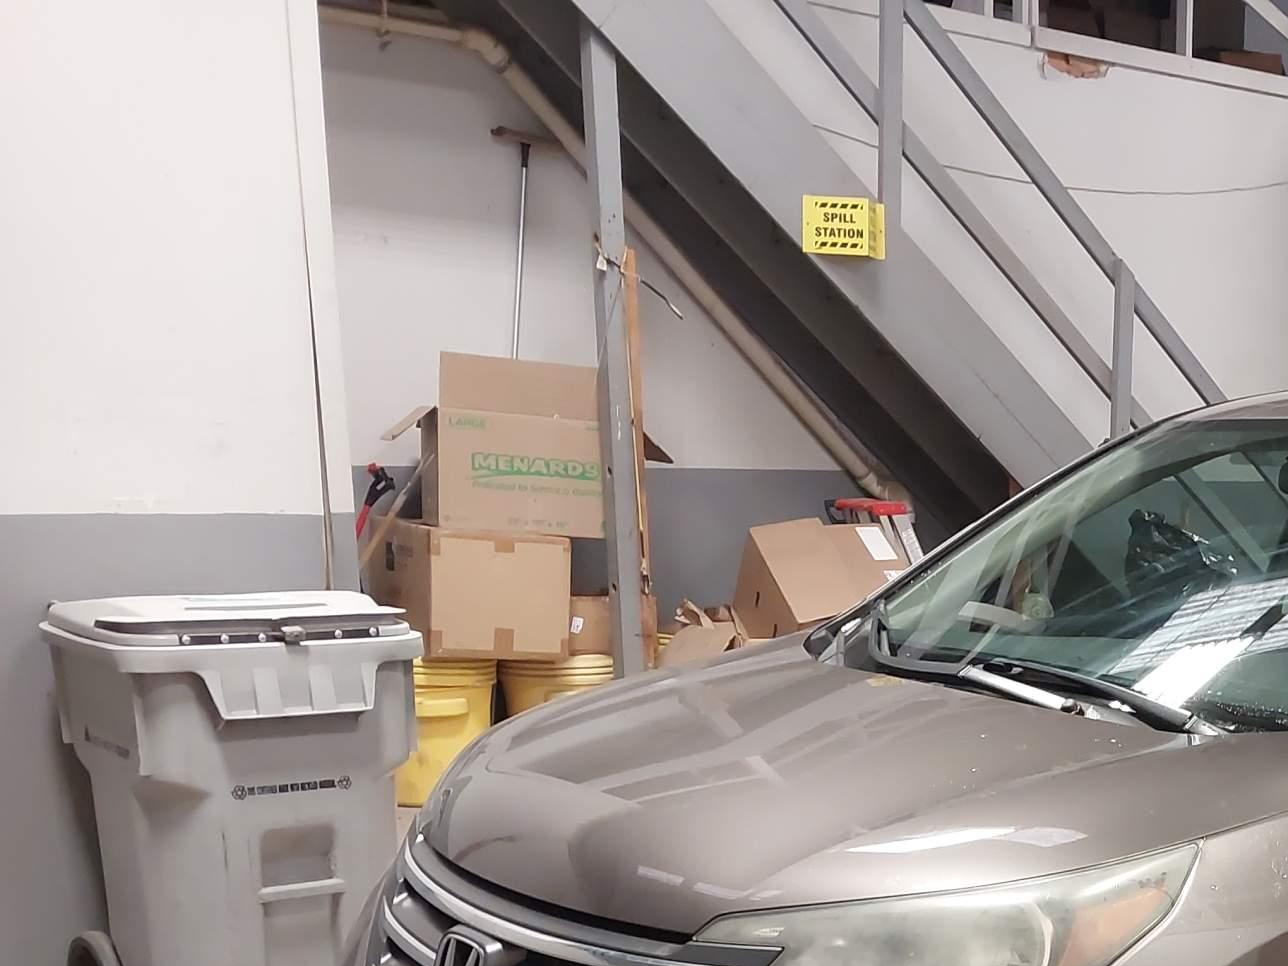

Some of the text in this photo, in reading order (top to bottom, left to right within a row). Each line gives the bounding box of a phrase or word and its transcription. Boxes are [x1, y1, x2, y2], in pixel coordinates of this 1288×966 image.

[823, 212, 856, 224] SPILL
[815, 226, 864, 239] STATION
[471, 452, 600, 480] MENARDS
